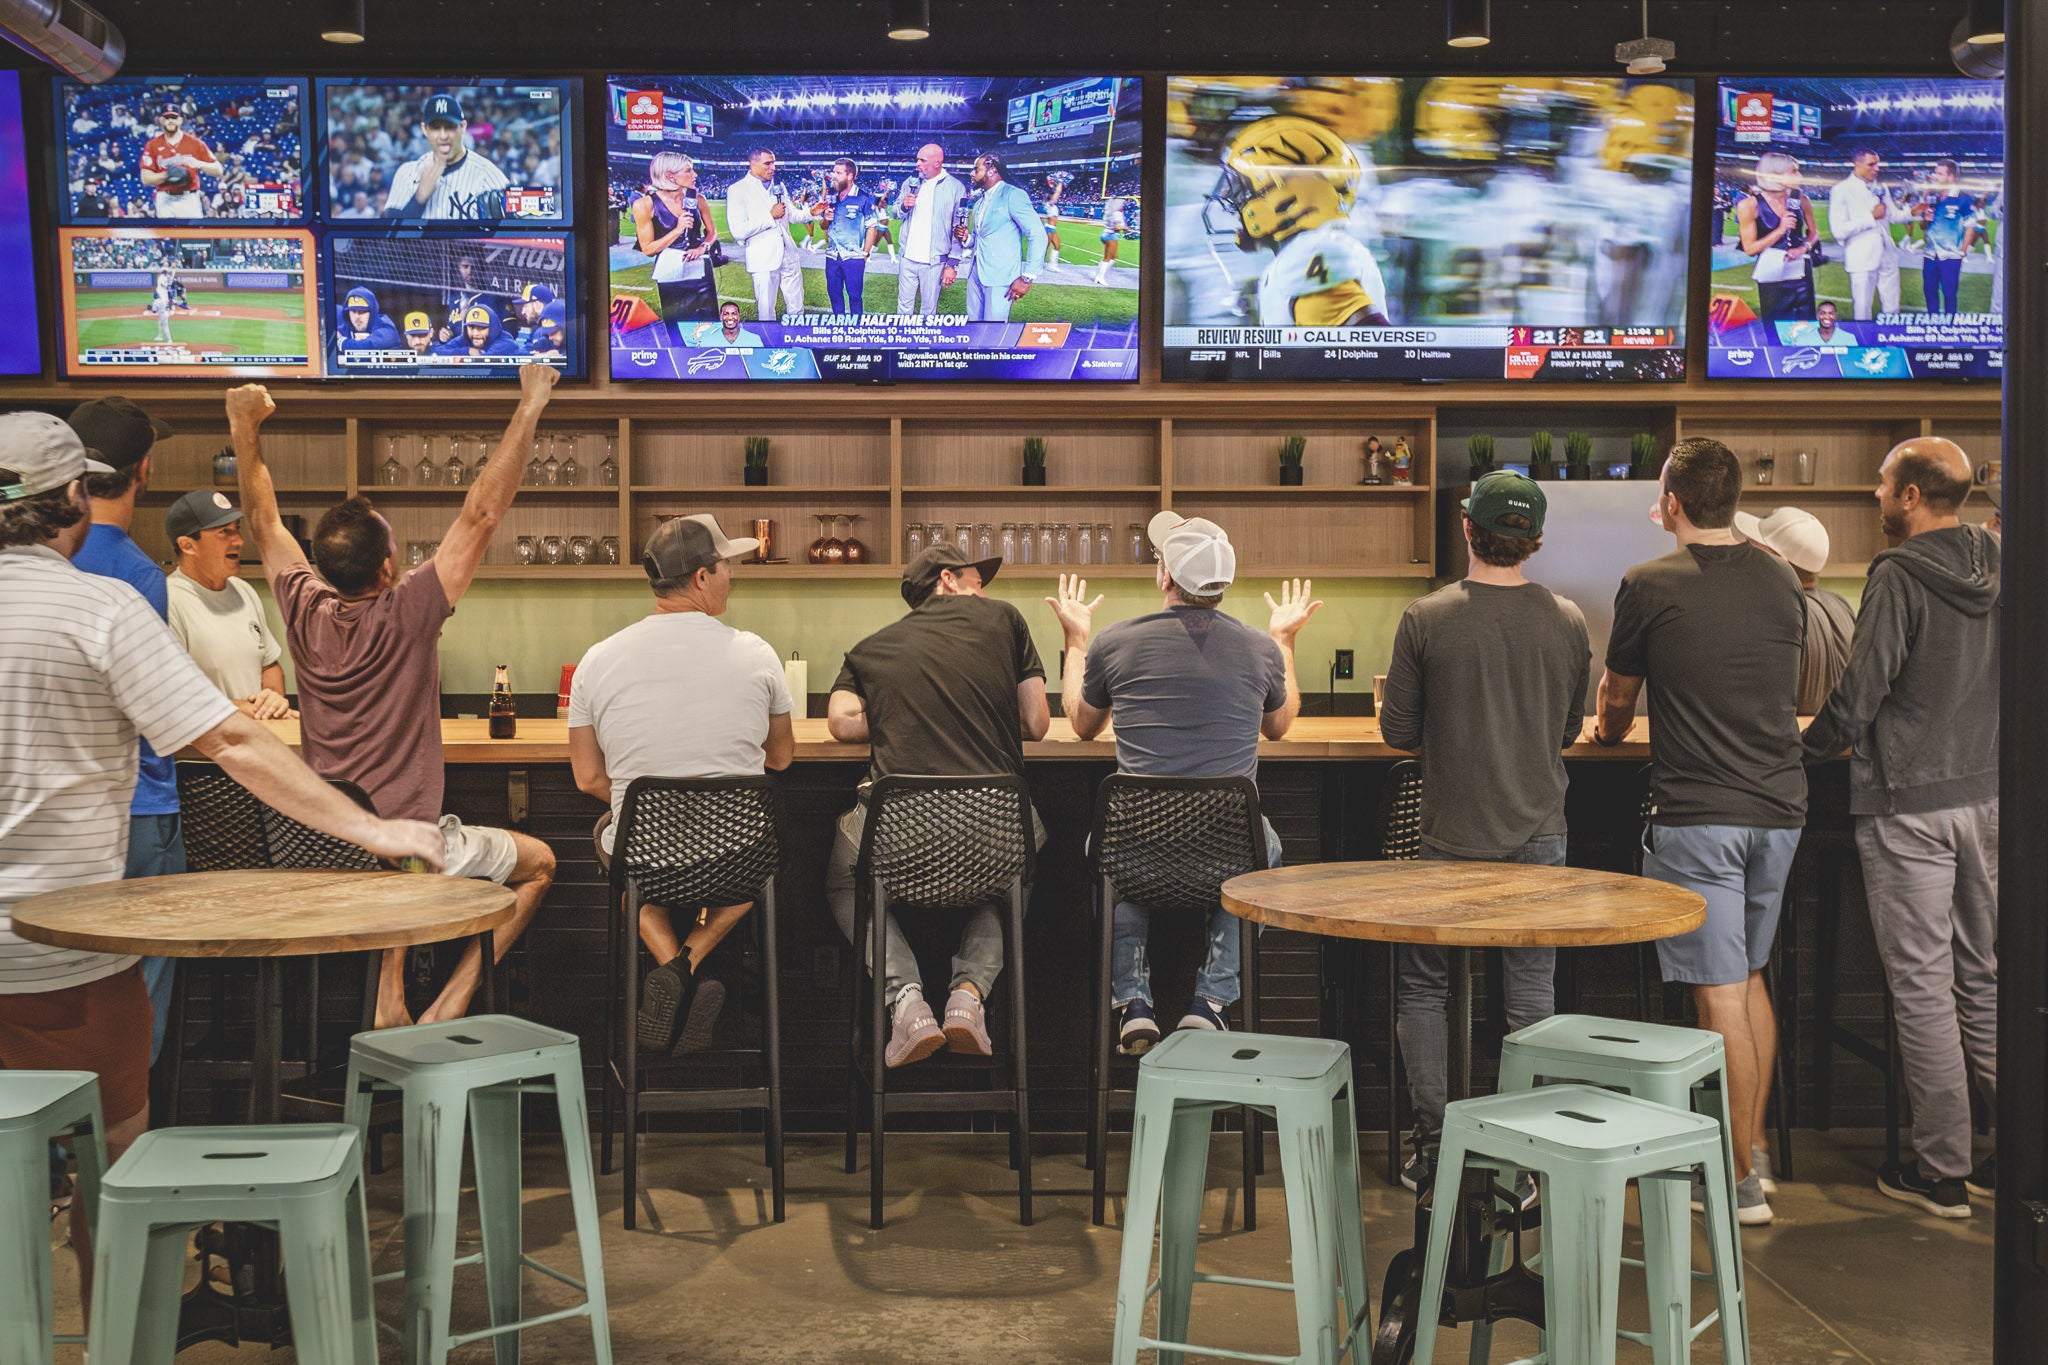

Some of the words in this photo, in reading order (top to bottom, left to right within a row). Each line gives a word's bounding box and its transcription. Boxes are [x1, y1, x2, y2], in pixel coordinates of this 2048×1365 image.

[1306, 254, 1328, 285] 4
[781, 314, 820, 327] STATE
[820, 314, 859, 327] FARM
[860, 314, 925, 327] HALFTIME
[925, 314, 969, 327] SHOW
[1876, 313, 1915, 326] STATE
[1914, 313, 1953, 326] FARM
[812, 326, 832, 335] Bills
[832, 327, 847, 336] 24,
[847, 326, 886, 338] Dolphins
[887, 327, 898, 335] 10
[904, 326, 942, 335] Halftime
[1198, 329, 1241, 344] REVIEW
[1244, 329, 1283, 344] RESULT
[1304, 331, 1346, 343] CALL
[1350, 331, 1437, 343] REVERSED
[1532, 330, 1556, 344] 21
[1583, 330, 1606, 344] 21
[784, 335, 794, 343] D.
[795, 334, 831, 343] Achane:
[831, 335, 844, 343] 69
[844, 335, 867, 343] Rush
[895, 335, 912, 343] Rec
[938, 335, 955, 343] Rec
[956, 335, 970, 343] TD
[1623, 337, 1655, 345] REVIEW
[631, 351, 658, 362] prime
[823, 354, 839, 362] BUF
[840, 354, 851, 362] 24
[856, 354, 872, 362] MIA
[873, 354, 883, 362] 10
[898, 352, 938, 361] Tagovailoa
[962, 352, 973, 360] 1st
[973, 352, 991, 360] time
[991, 352, 999, 360] in
[999, 352, 1011, 360] his
[1011, 352, 1037, 360] career
[1190, 350, 1227, 361] ESPN
[1235, 350, 1250, 359] NFL
[1263, 350, 1281, 358] Bills
[1324, 350, 1337, 358] 24
[1342, 350, 1378, 360] Dolphins
[1404, 350, 1416, 358] 10
[1421, 351, 1451, 359] Halftime
[1509, 355, 1540, 363] COLLEGE
[1550, 350, 1571, 360] UNLV
[1581, 350, 1613, 360] KANSAS
[897, 360, 914, 368] with
[915, 360, 921, 368] 2
[921, 360, 935, 368] INT
[935, 360, 943, 368] in
[944, 360, 954, 368] 1st
[1550, 360, 1576, 368] FRIDAY
[1581, 360, 1591, 368] PM
